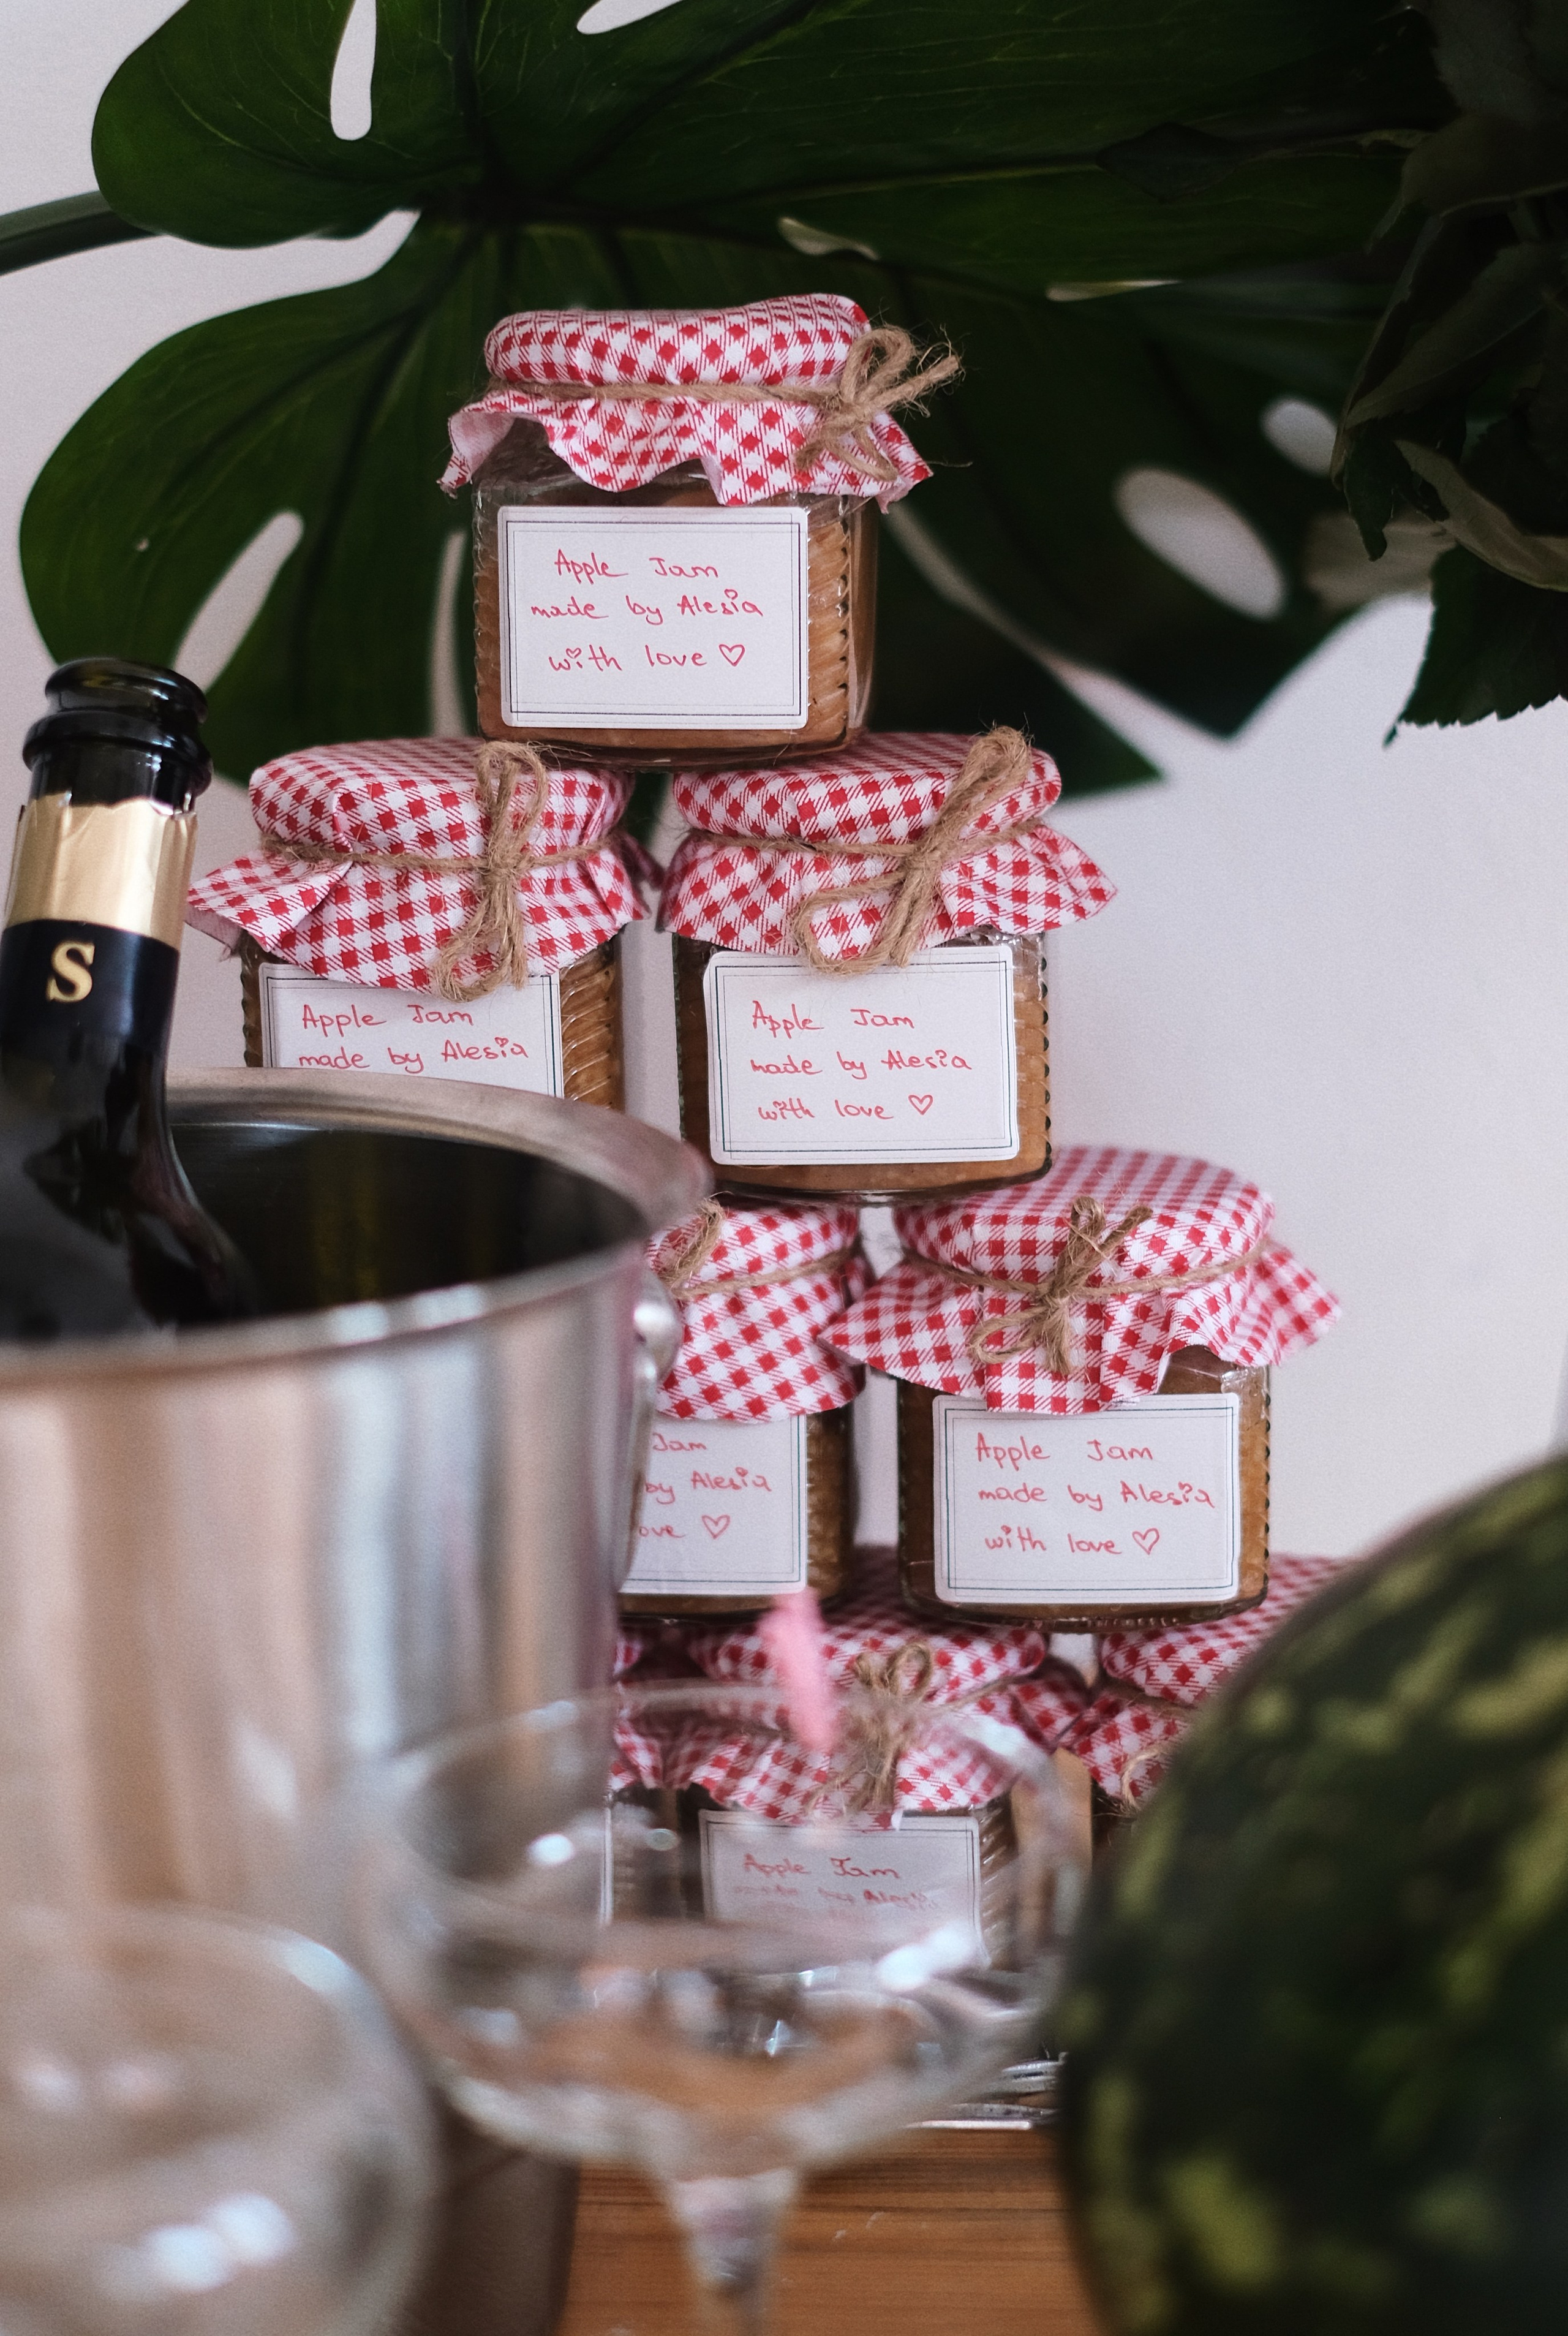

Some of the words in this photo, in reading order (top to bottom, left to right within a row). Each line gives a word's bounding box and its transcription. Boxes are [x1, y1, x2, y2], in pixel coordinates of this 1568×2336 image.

[554, 548, 628, 584] Apple
[649, 556, 718, 578] Jam
[530, 595, 609, 619] made
[625, 594, 664, 626] by
[677, 589, 764, 616] Alesia
[549, 644, 622, 671] with
[645, 644, 707, 667] love
[47, 942, 95, 1002] S
[302, 1004, 387, 1037] Apple
[408, 1004, 473, 1026] Jam
[752, 1000, 824, 1038] Apple
[850, 1008, 914, 1029] Jam
[298, 1046, 370, 1070] made
[387, 1047, 424, 1074] by
[441, 1036, 529, 1062] Alesia
[750, 1055, 823, 1075] made
[836, 1051, 867, 1080] by
[881, 1049, 972, 1070] Alesia
[758, 1097, 815, 1121] with
[834, 1099, 894, 1120] love
[652, 1432, 707, 1452] Jam
[975, 1432, 1050, 1471] Apple
[1087, 1439, 1154, 1462] Jam
[690, 1466, 772, 1492] Alesia
[978, 1483, 1048, 1503] made
[1067, 1484, 1104, 1512] by
[1120, 1480, 1215, 1508] Alesia
[638, 1524, 687, 1539] ove
[985, 1524, 1046, 1551] with
[1068, 1533, 1123, 1555] love
[830, 1857, 900, 1879] Jam
